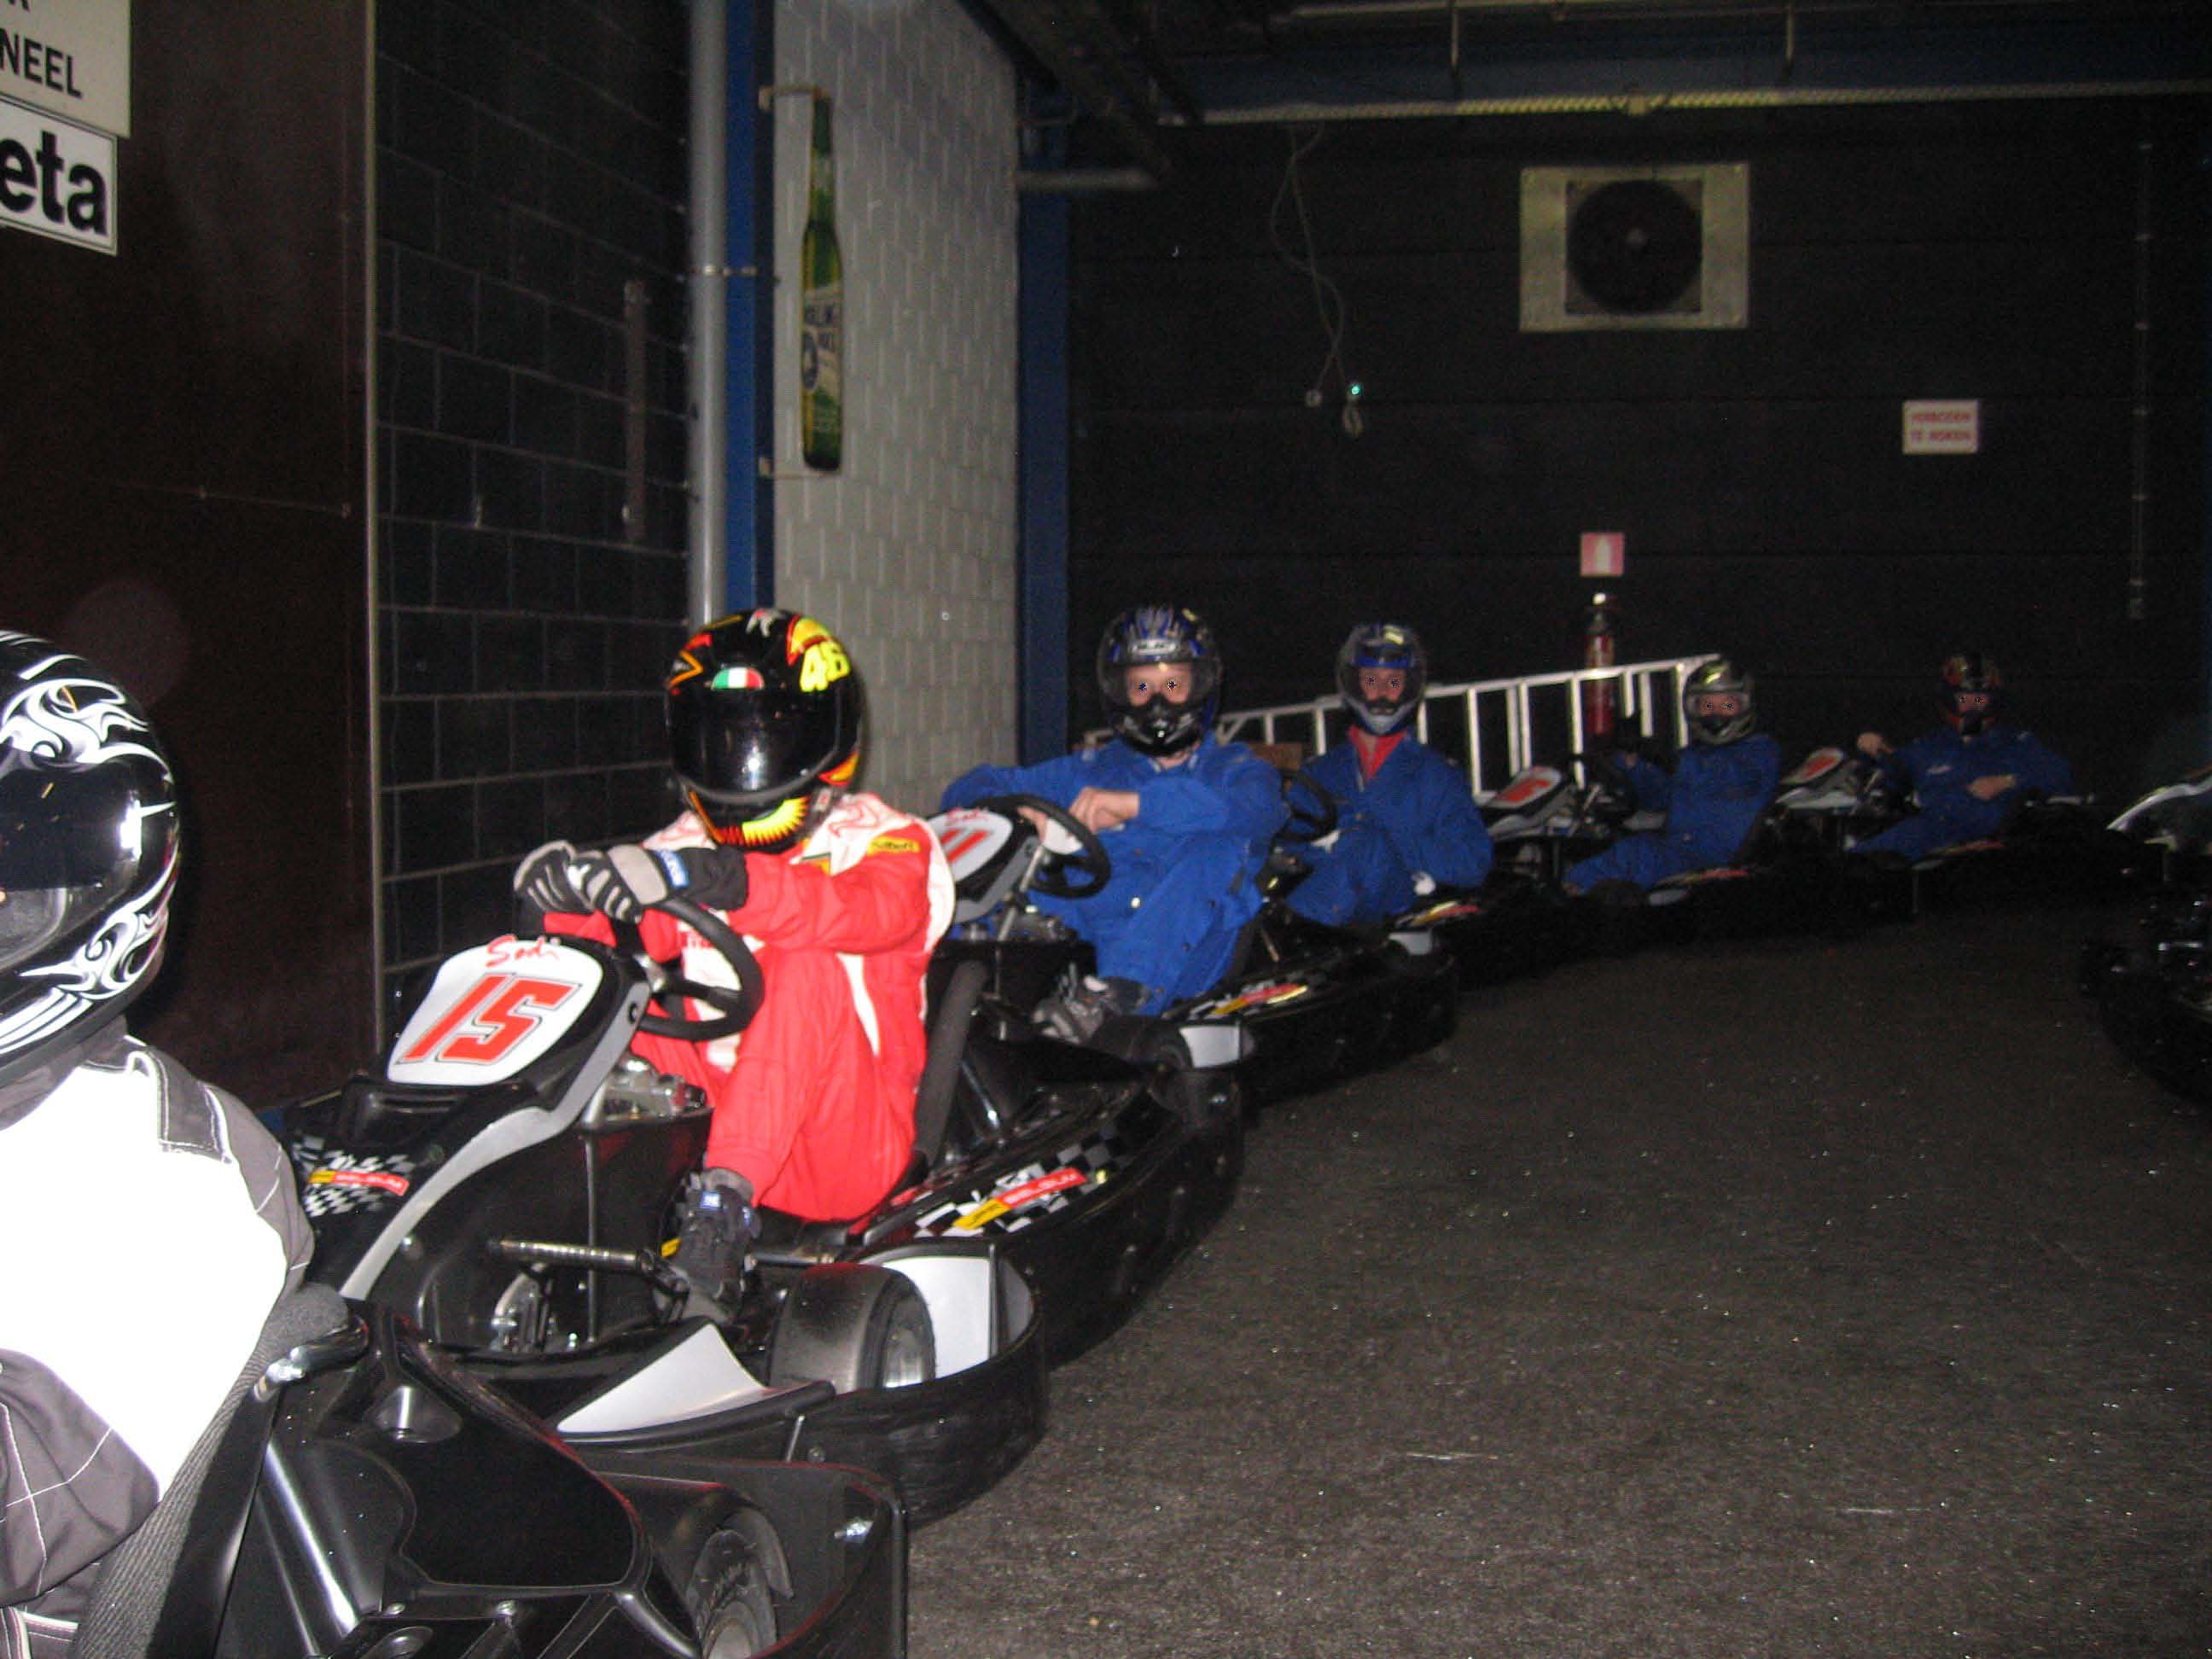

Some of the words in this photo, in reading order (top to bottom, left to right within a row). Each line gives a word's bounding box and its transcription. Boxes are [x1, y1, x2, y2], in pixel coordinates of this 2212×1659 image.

[0, 28, 82, 99] NEEL
[0, 130, 108, 236] eta
[800, 641, 850, 692] 46
[394, 971, 583, 1065] 15
